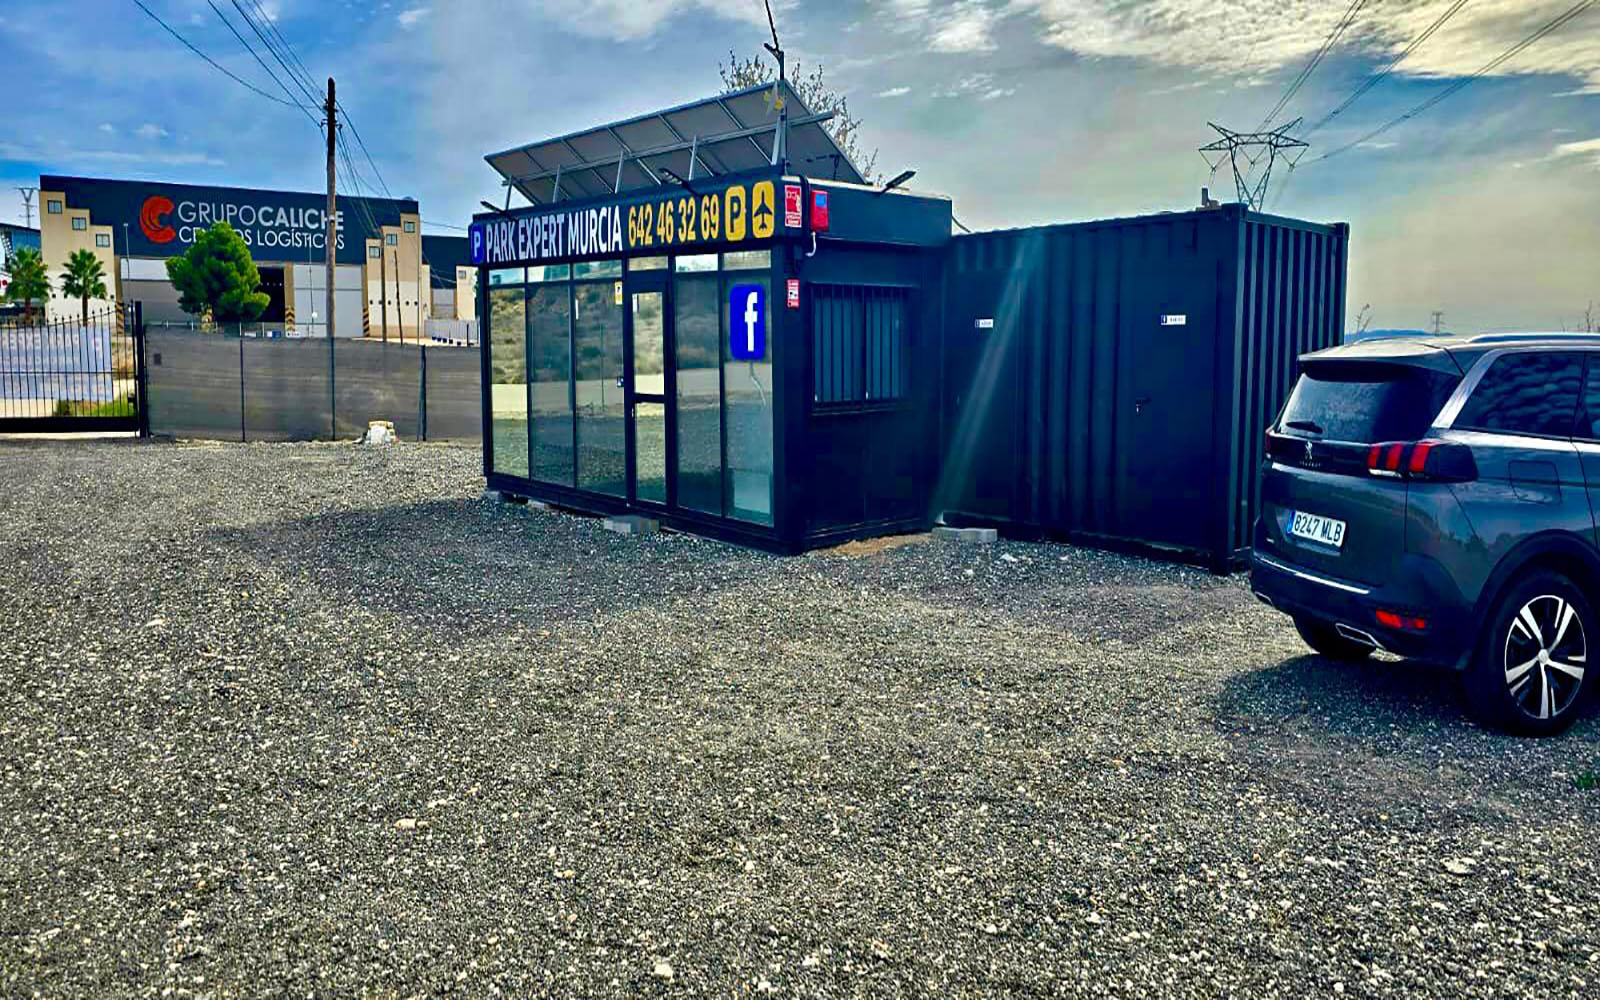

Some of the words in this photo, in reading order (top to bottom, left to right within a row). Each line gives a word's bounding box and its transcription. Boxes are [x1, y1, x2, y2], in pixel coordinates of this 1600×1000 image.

[486, 221, 516, 263] PARK
[518, 213, 565, 260] EXPERT
[567, 205, 623, 256] MURCIA
[628, 203, 653, 248] 642
[656, 200, 674, 244] 46
[678, 197, 696, 243] 32
[701, 194, 720, 240] 69
[1294, 514, 1320, 535] 8247
[1320, 519, 1342, 542] MLB
